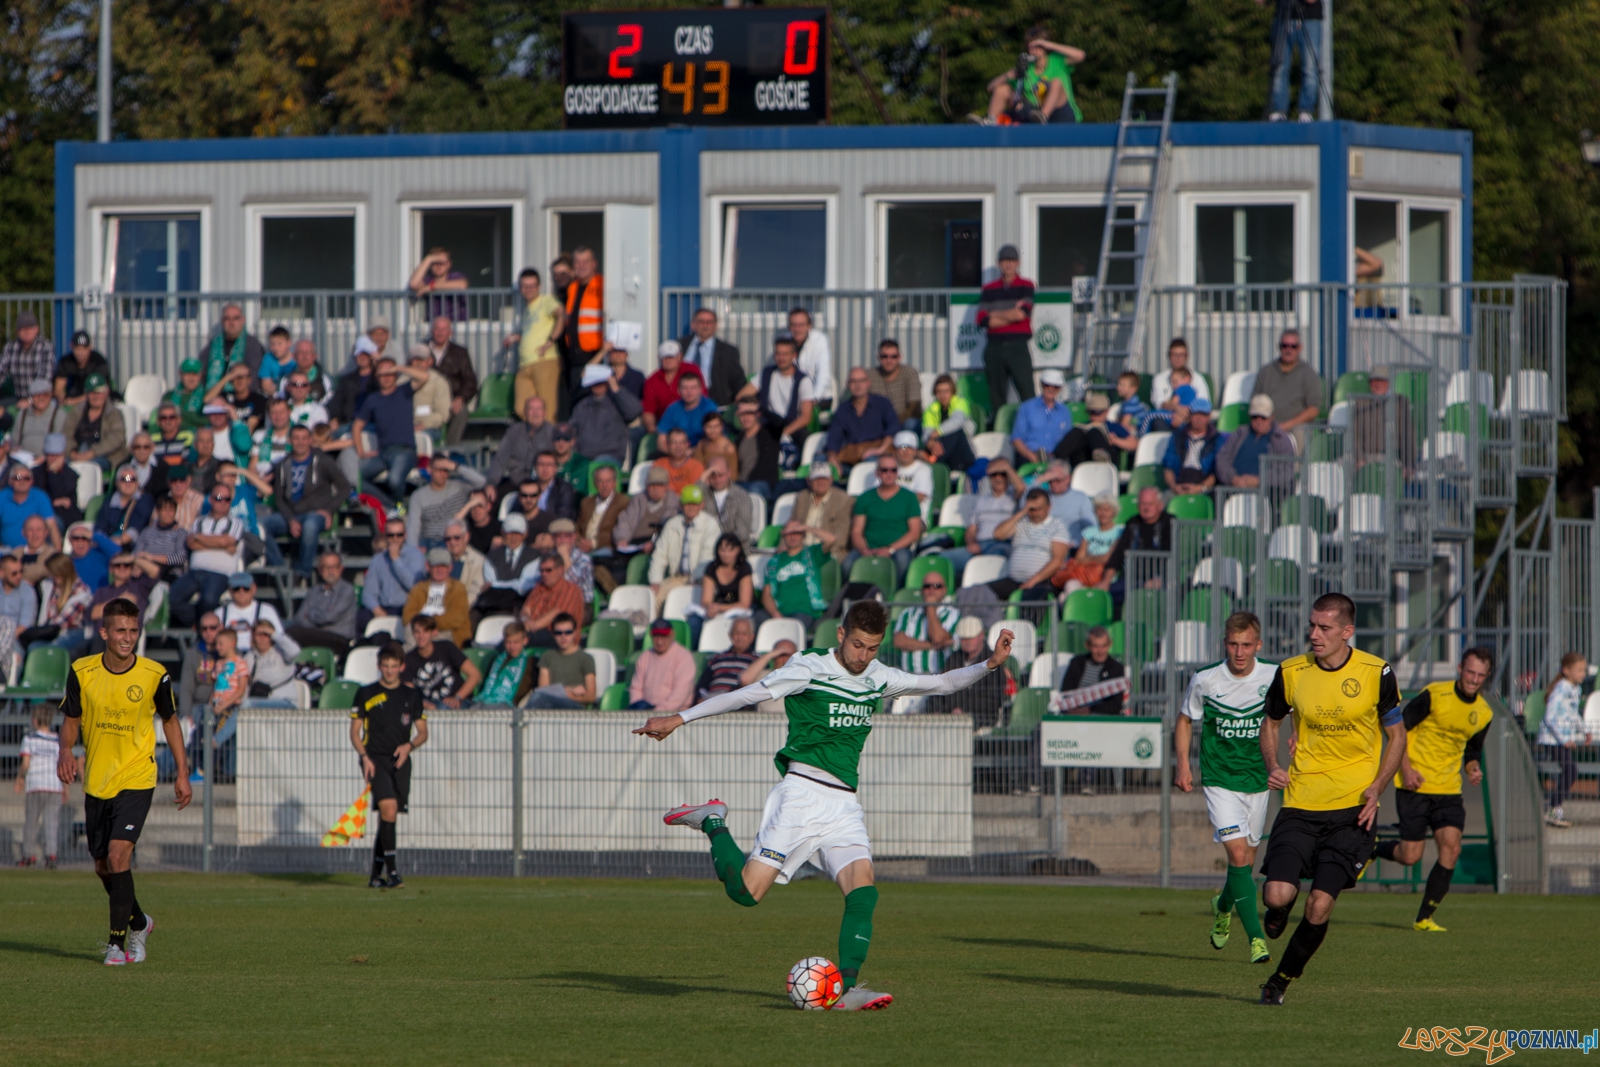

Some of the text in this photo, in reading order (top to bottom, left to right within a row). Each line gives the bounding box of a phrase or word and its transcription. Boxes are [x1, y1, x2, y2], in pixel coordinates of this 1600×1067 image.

[608, 23, 643, 79] 2
[674, 25, 713, 55] CZAS
[783, 20, 820, 75] 0
[564, 84, 659, 114] GOSPODARZE
[662, 60, 731, 115] 43
[755, 75, 810, 111] GOŚCIE
[829, 716, 872, 727] HOUS
[1215, 716, 1264, 728] FAMILY
[1047, 751, 1103, 761] TECHNICZNY
